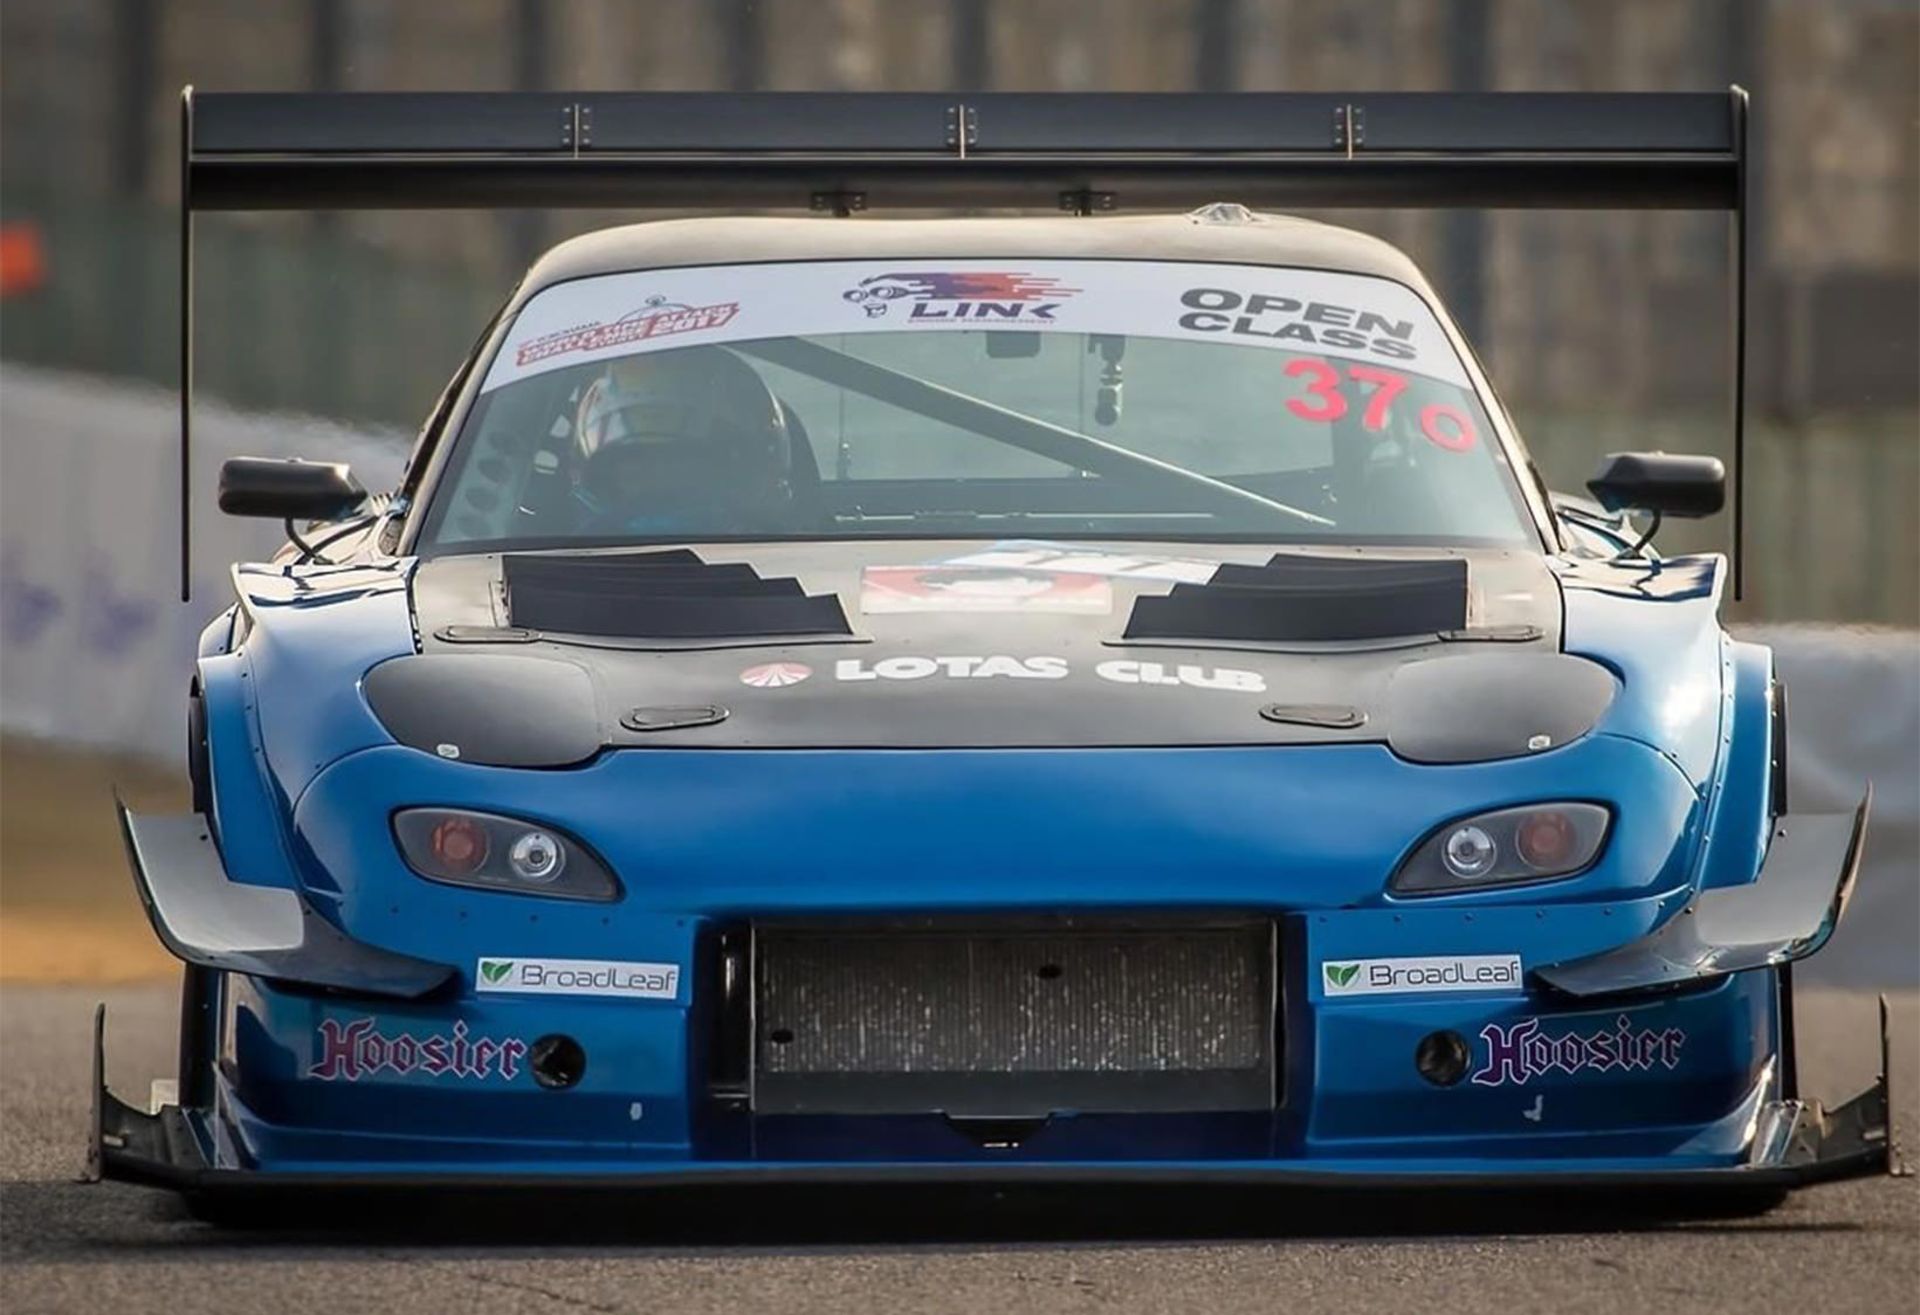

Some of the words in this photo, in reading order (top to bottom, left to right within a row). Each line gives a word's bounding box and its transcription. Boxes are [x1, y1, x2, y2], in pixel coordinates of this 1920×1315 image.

[910, 303, 1061, 318] LINK
[1180, 288, 1414, 340] OPEN
[1178, 313, 1416, 360] CLASS
[836, 656, 1068, 680] LOTAS
[1095, 660, 1267, 692] CLUB
[521, 964, 676, 992] BroadLeaf
[1369, 961, 1520, 987] BroadLeaf
[308, 1016, 528, 1081] Hoosier
[1471, 1014, 1686, 1086] Hoosier
